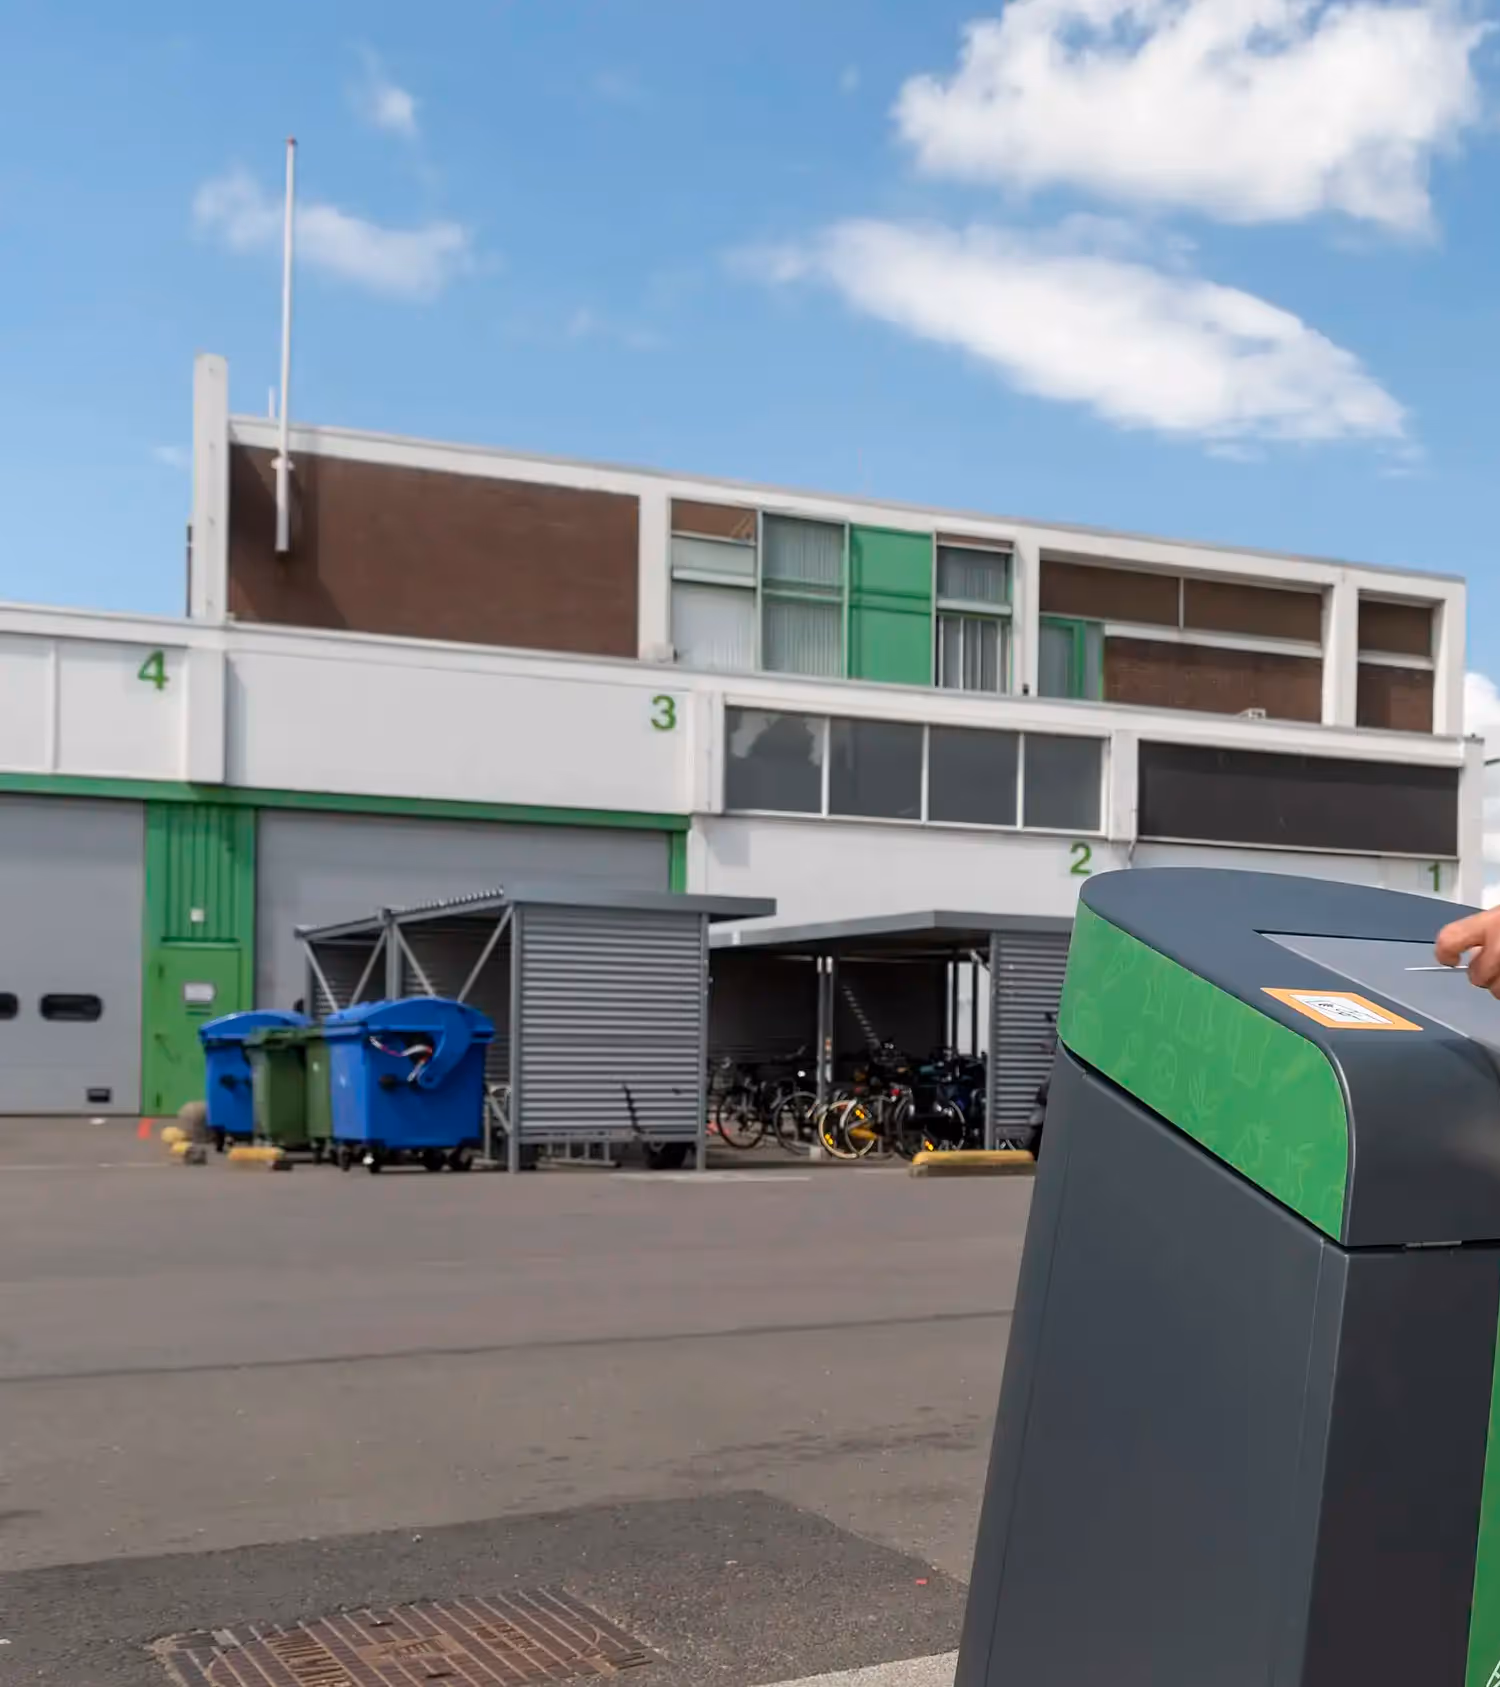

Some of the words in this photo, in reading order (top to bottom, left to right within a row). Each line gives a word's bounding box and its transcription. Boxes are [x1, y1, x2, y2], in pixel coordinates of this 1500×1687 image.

[138, 650, 170, 690] 4
[651, 694, 677, 731] 3
[1070, 842, 1092, 875] 2
[1428, 861, 1440, 891] 1
